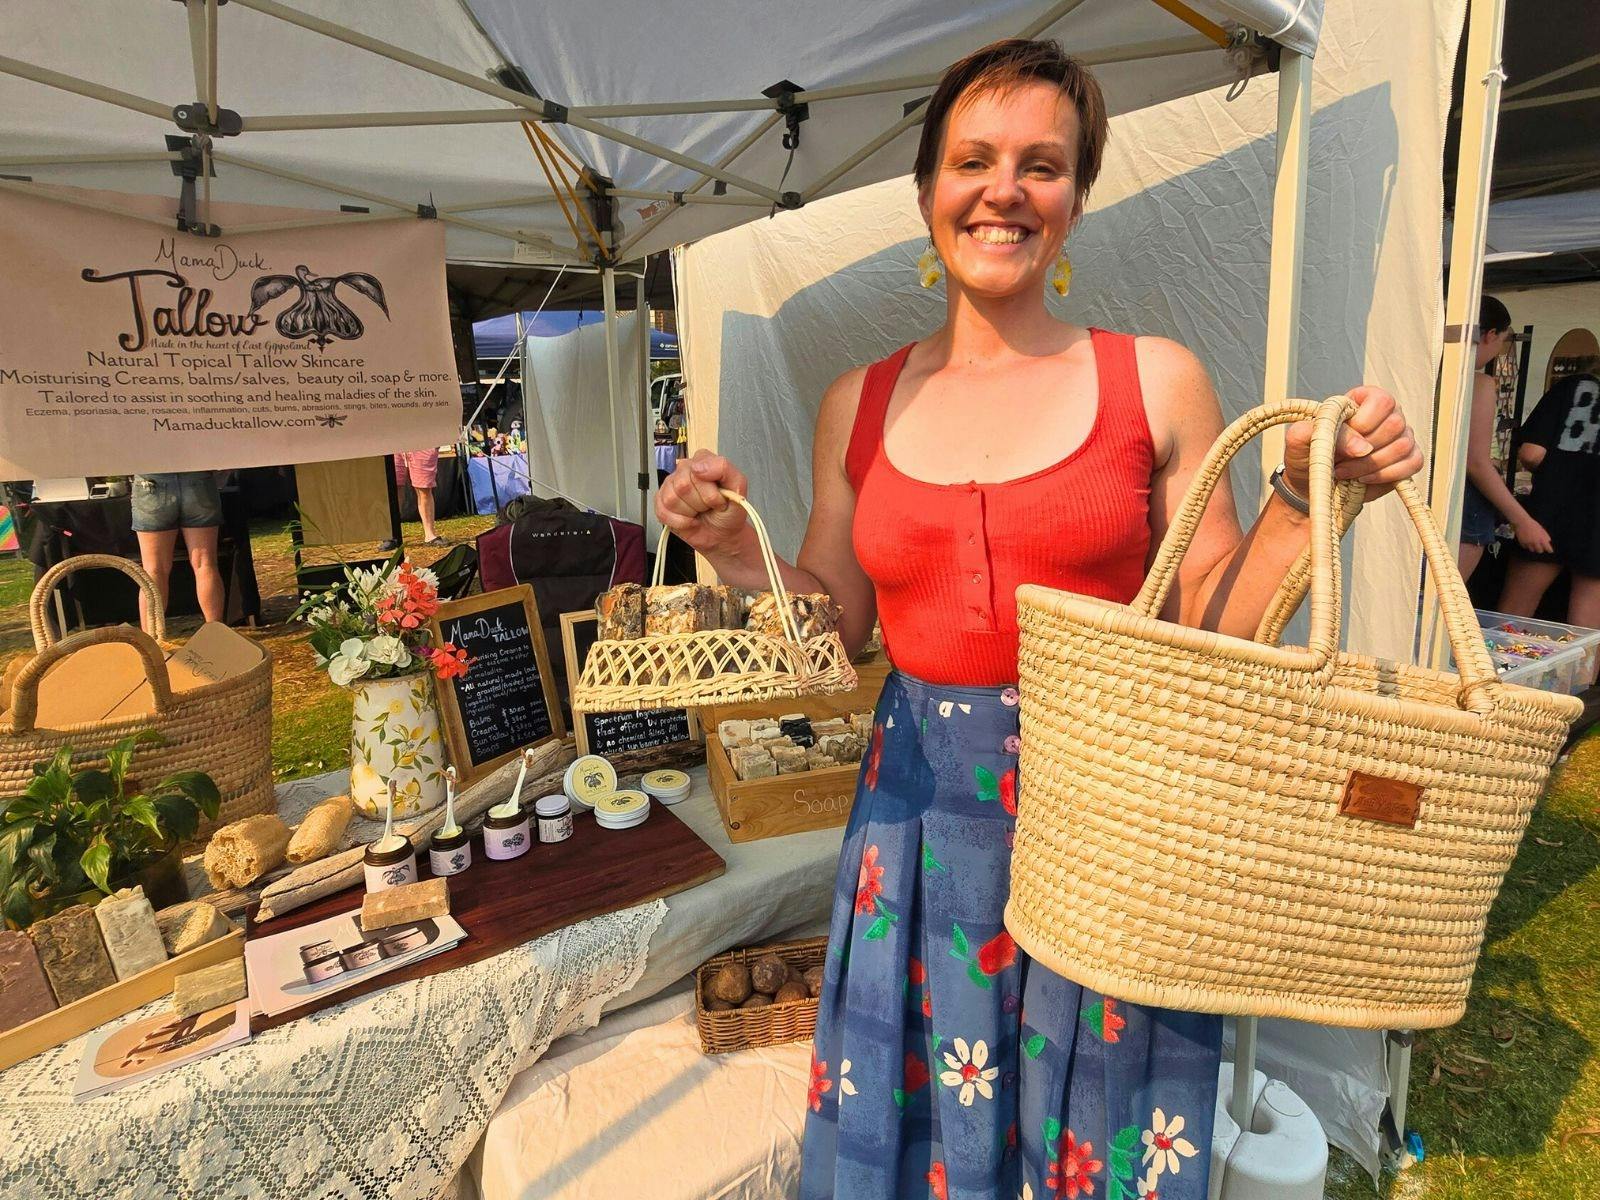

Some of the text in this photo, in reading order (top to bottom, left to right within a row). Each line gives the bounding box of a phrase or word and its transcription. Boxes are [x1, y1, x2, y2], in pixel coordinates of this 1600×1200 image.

[81, 268, 269, 352] Tallow
[149, 338, 311, 355] Made in the heart of East Gippsland
[87, 350, 365, 370] Natural Topical Tallow Skincare
[0, 369, 452, 387] Moisturising Creams, balms/salves, beauty oil, soap & more.
[38, 387, 437, 404] Tailored to assist in soothing and healing maladies of the skin.
[26, 408, 71, 416] Eczema,
[152, 407, 190, 415] rosacea,
[193, 405, 250, 414] inflammation,
[252, 405, 272, 413] cuts,
[302, 403, 341, 412] abrasions,
[154, 416, 315, 431] Mamaducktallow.com
[492, 626, 529, 643] TALLOW
[469, 716, 492, 728] Balms
[594, 713, 633, 729] Spectrum
[597, 727, 616, 737] that
[619, 721, 643, 732] offers
[471, 724, 498, 738] Creams
[618, 731, 647, 744] chemical
[473, 737, 488, 747] Sun
[793, 789, 849, 817] Soap
